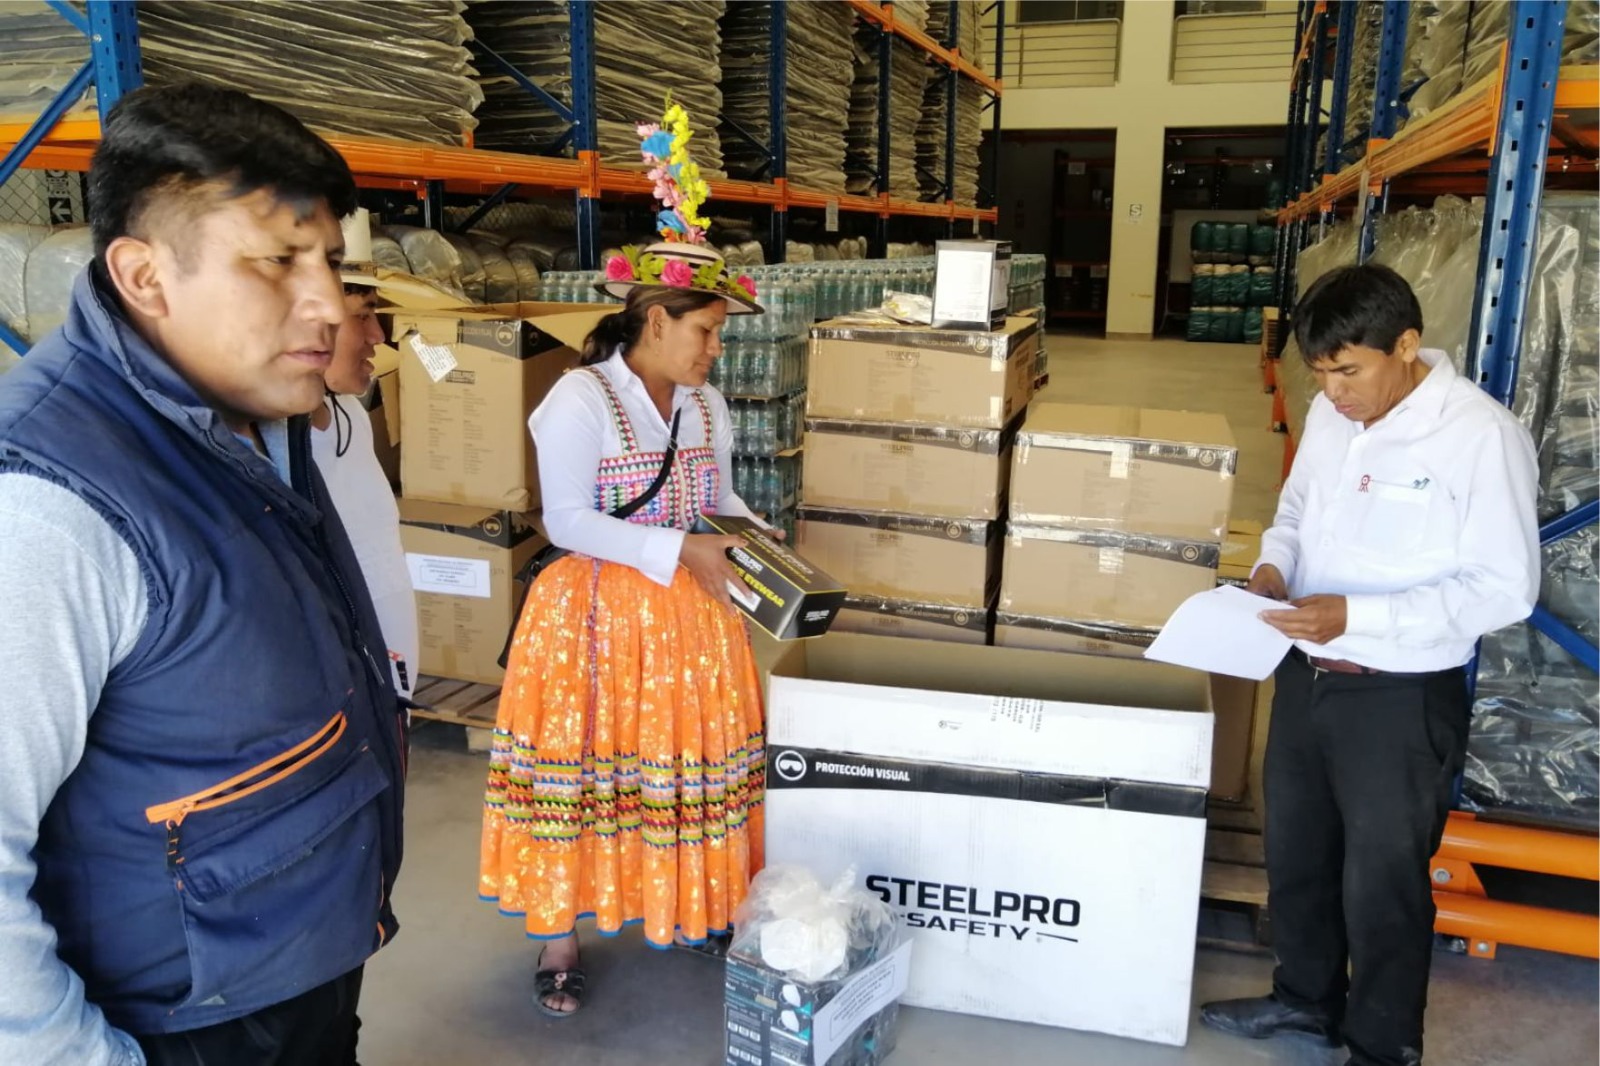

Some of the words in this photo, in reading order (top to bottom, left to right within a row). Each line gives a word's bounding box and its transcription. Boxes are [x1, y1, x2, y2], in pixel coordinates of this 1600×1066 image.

[743, 573, 785, 608] EYEWEAR
[815, 761, 874, 778] PROTECCIÓN
[875, 768, 911, 782] VISUAL
[865, 874, 1081, 927] STEELPRO
[906, 911, 1031, 941] SAFETY
